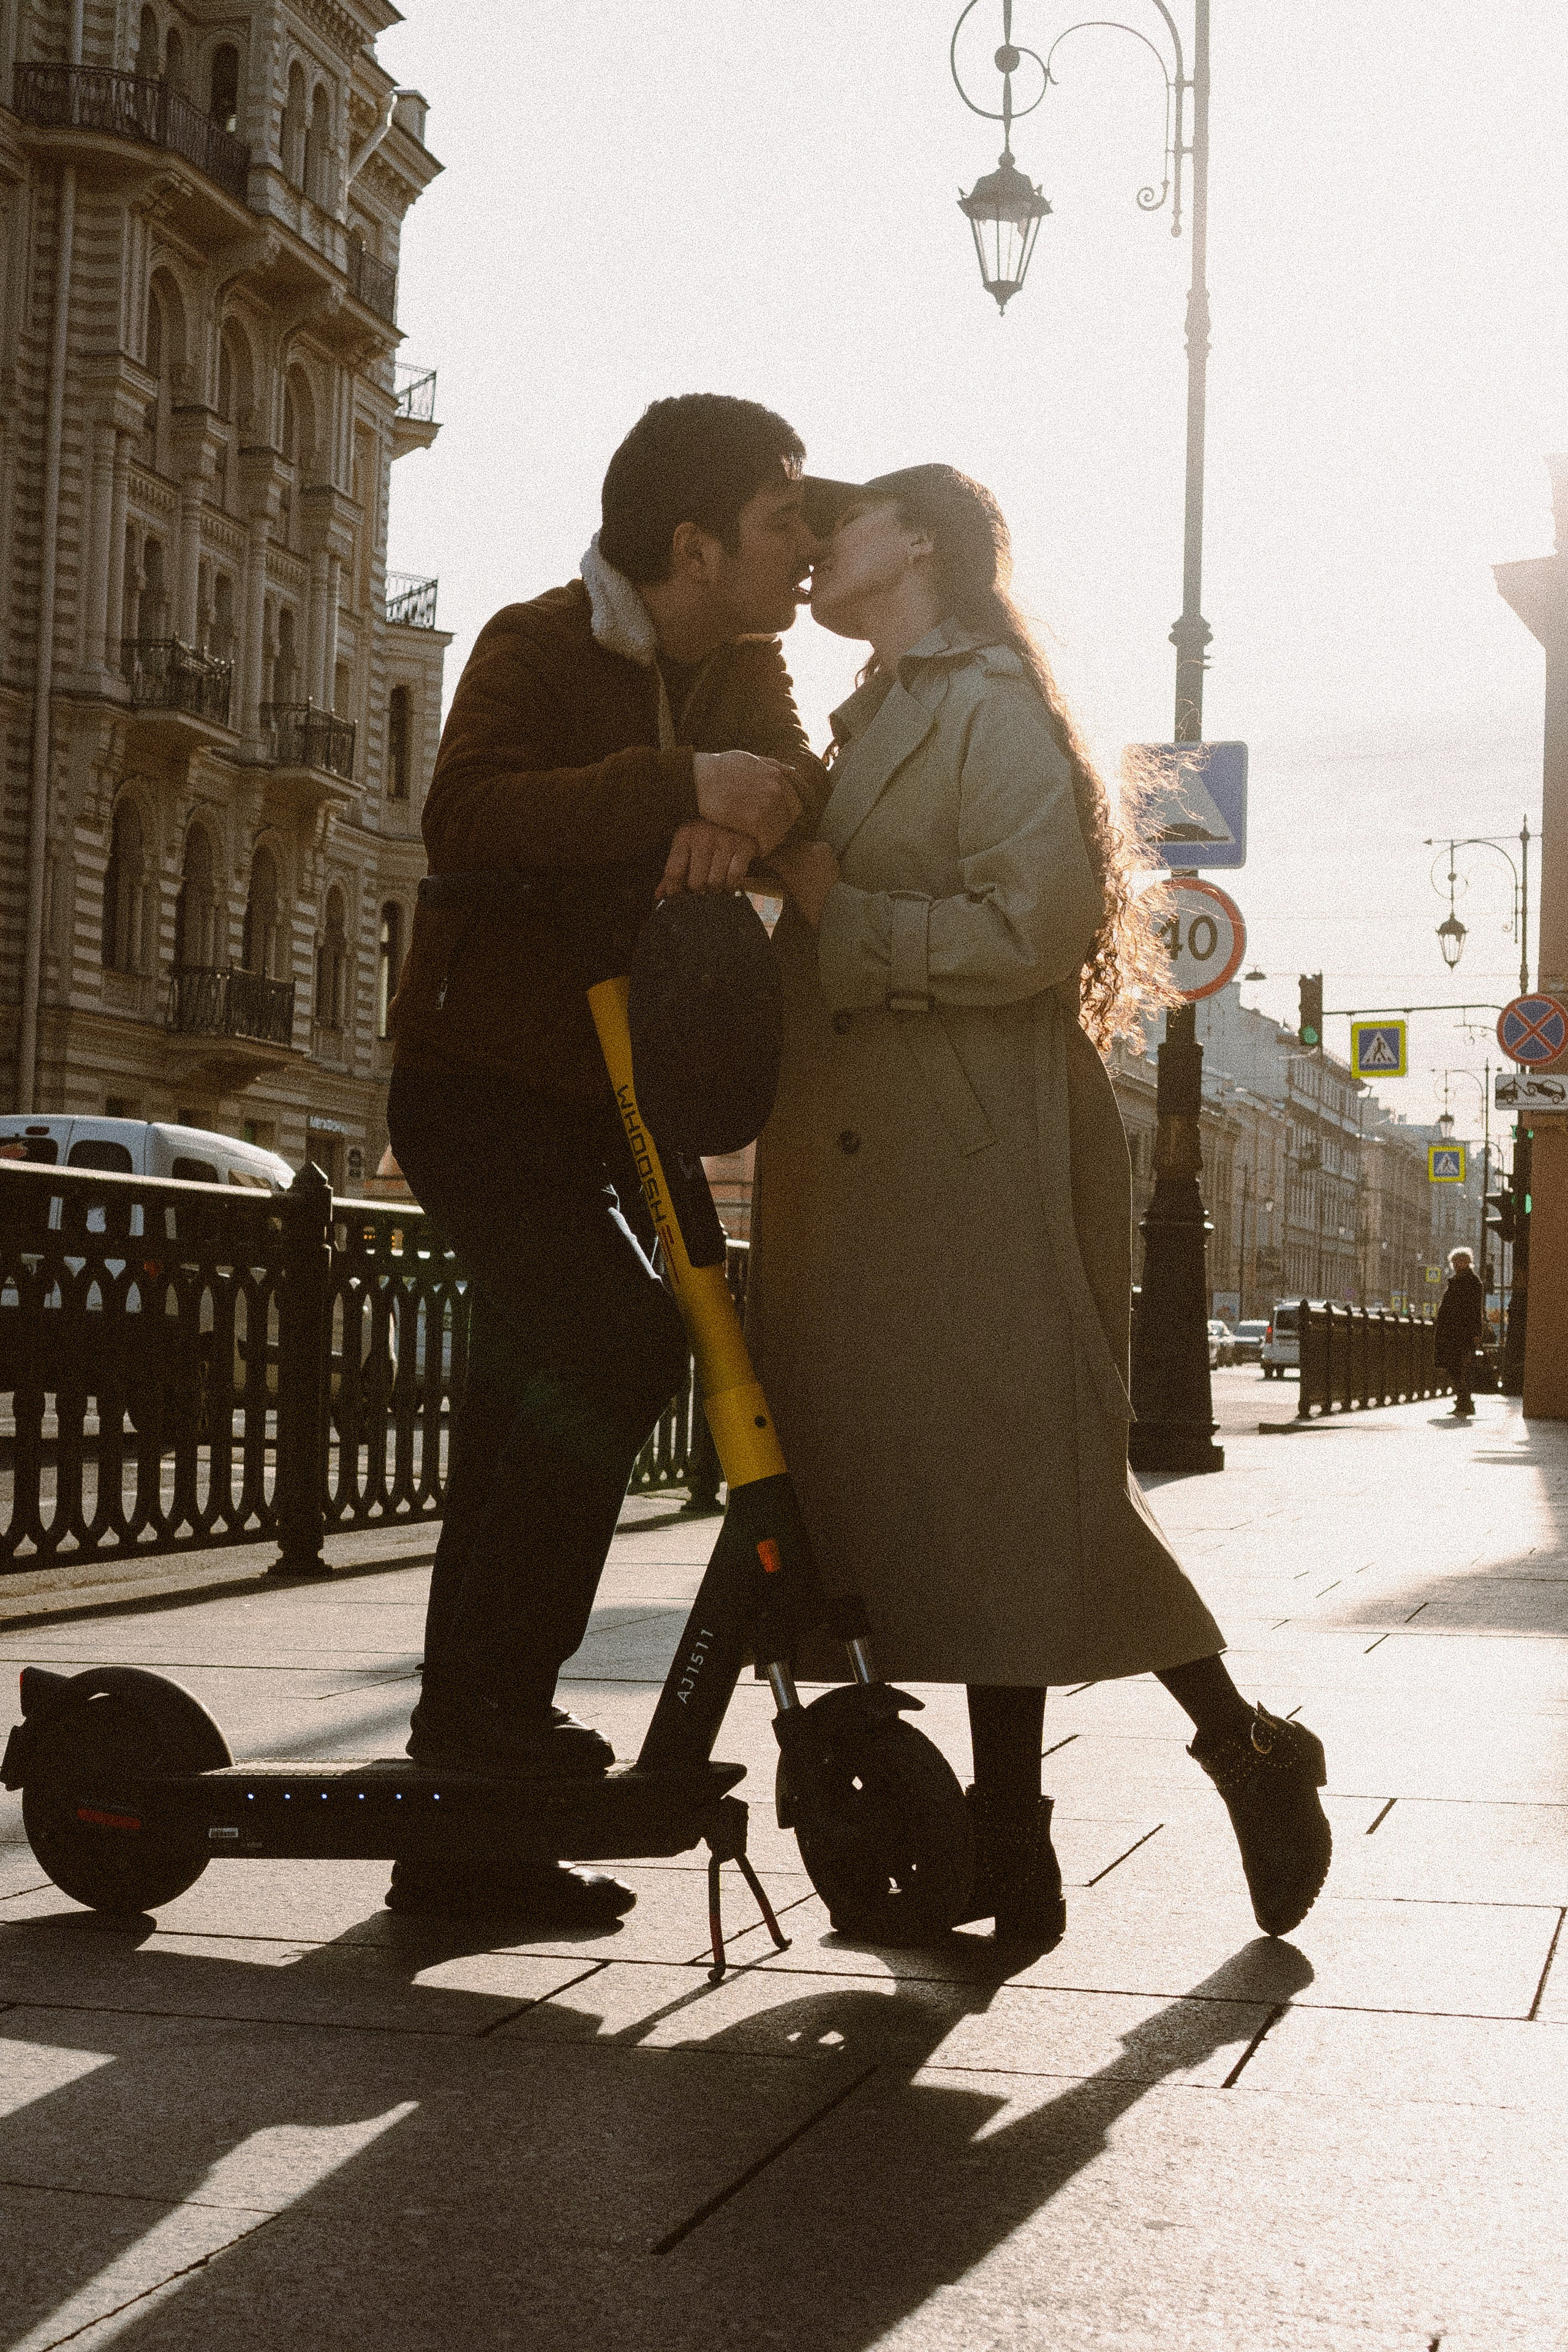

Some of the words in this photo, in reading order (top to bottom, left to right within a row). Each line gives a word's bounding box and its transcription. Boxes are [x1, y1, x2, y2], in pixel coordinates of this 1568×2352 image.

[1157, 914, 1218, 960] 40
[616, 1084, 666, 1224] WHOOSH
[677, 1629, 714, 1704] AJ1511
